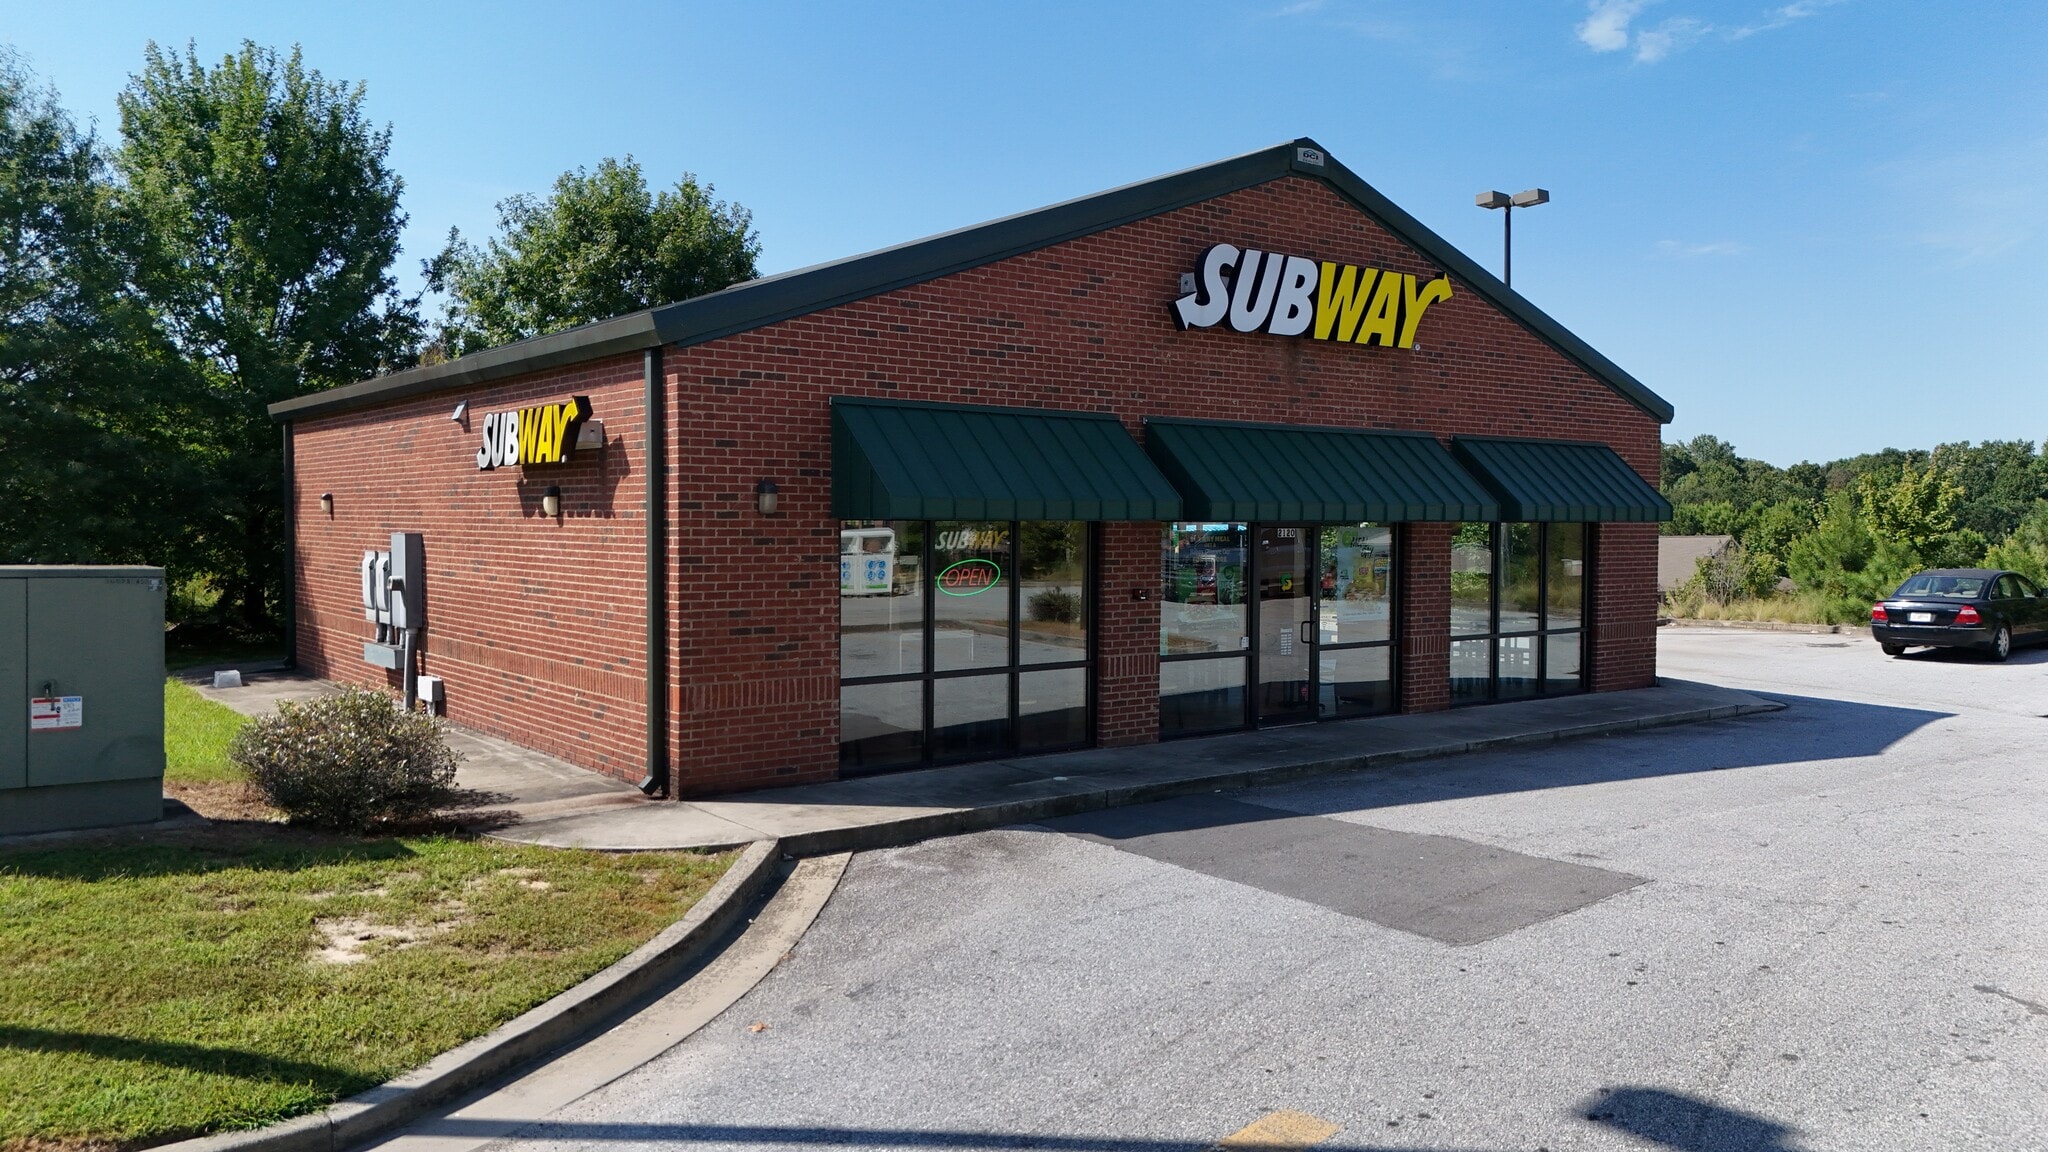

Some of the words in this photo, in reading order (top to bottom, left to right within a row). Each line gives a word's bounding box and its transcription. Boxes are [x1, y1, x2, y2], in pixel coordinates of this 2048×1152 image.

[1175, 243, 1454, 349] SUBWAY
[476, 398, 579, 469] SUBWAY
[935, 530, 1009, 549] SUBWAY
[1278, 529, 1295, 538] 2120
[946, 568, 993, 587] OPEN
